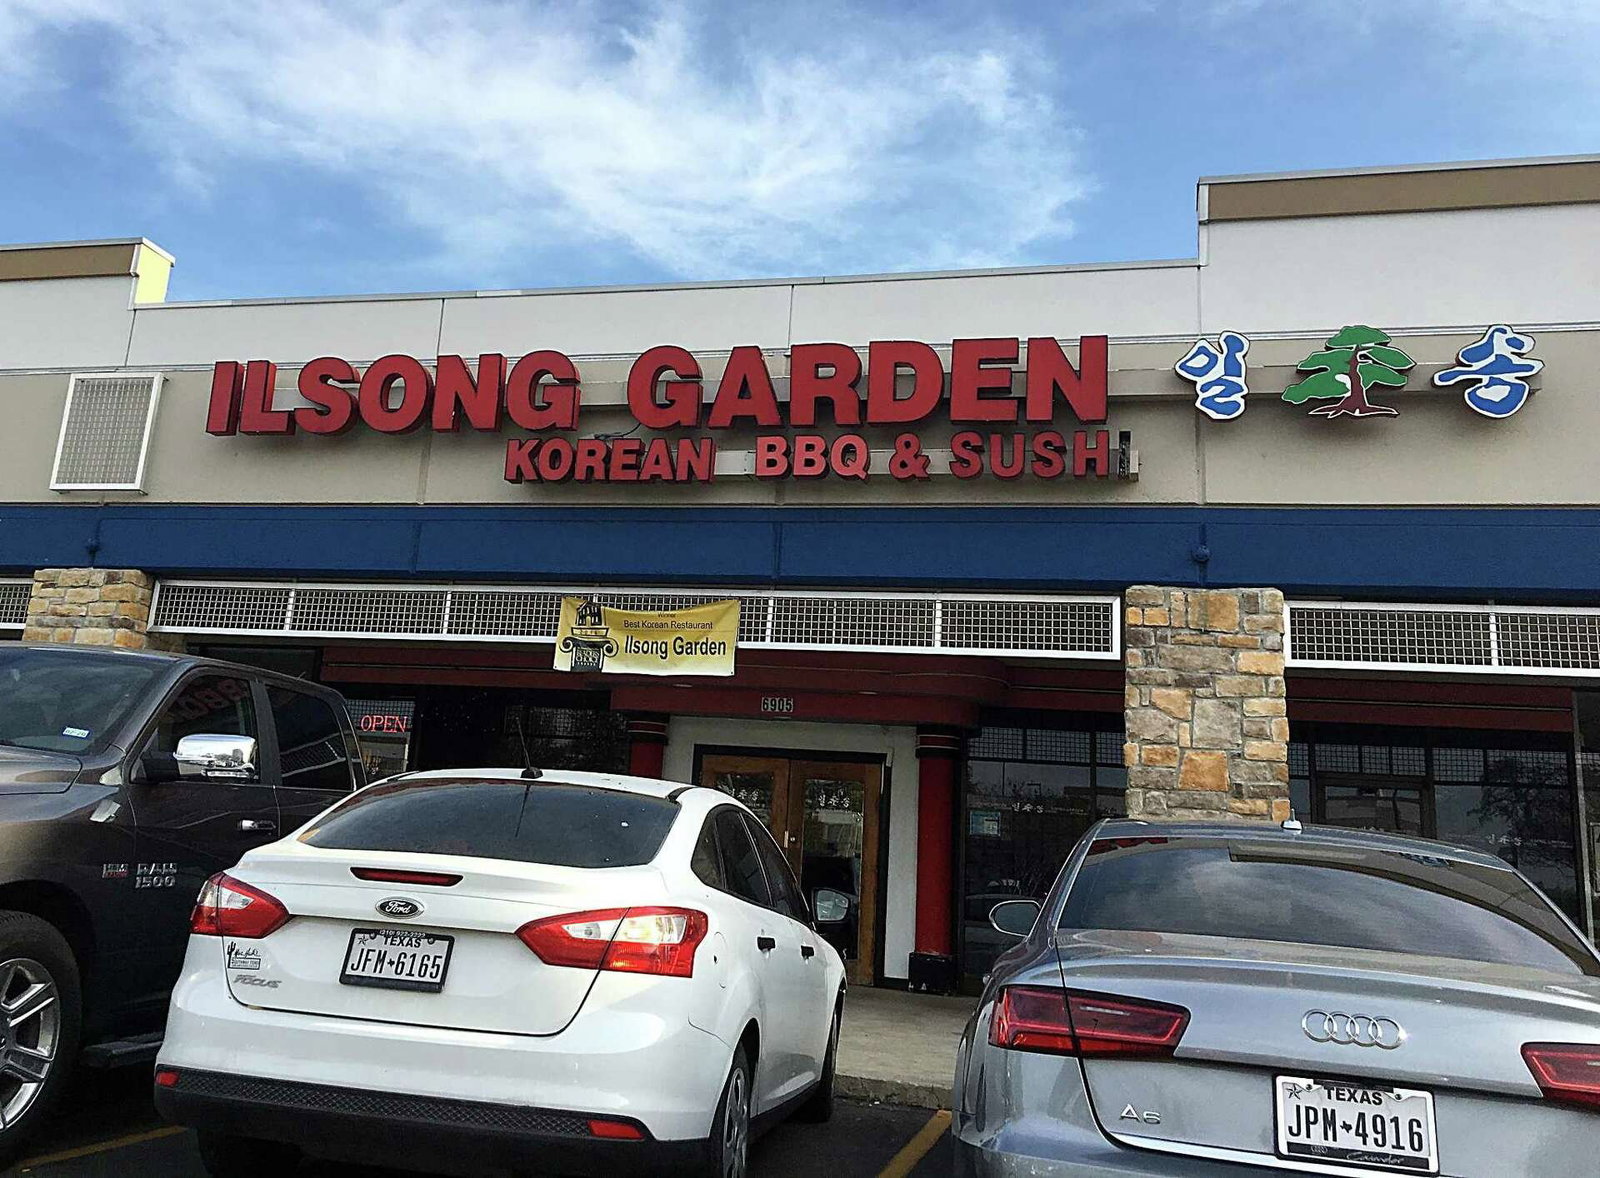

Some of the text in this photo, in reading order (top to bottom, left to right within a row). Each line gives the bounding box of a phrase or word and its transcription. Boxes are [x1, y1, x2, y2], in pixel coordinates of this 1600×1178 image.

[206, 335, 1108, 435] ILSONG GARDEN
[504, 437, 716, 484] KOREAN
[756, 434, 870, 483] BBQ
[889, 432, 930, 481] &
[623, 619, 713, 630] Best Korean Restaurant
[624, 635, 668, 660] Ilsong
[673, 636, 727, 656] Garden
[763, 698, 793, 712] 6905
[360, 714, 408, 733] OPEN
[135, 876, 176, 889] 1500
[385, 901, 412, 914] Ford
[383, 936, 422, 948] TEXAS
[351, 948, 443, 979] JFM 6165
[1323, 1086, 1382, 1106] TEXAS
[1119, 1103, 1161, 1125] A6
[1288, 1104, 1423, 1151] JPM 4916
